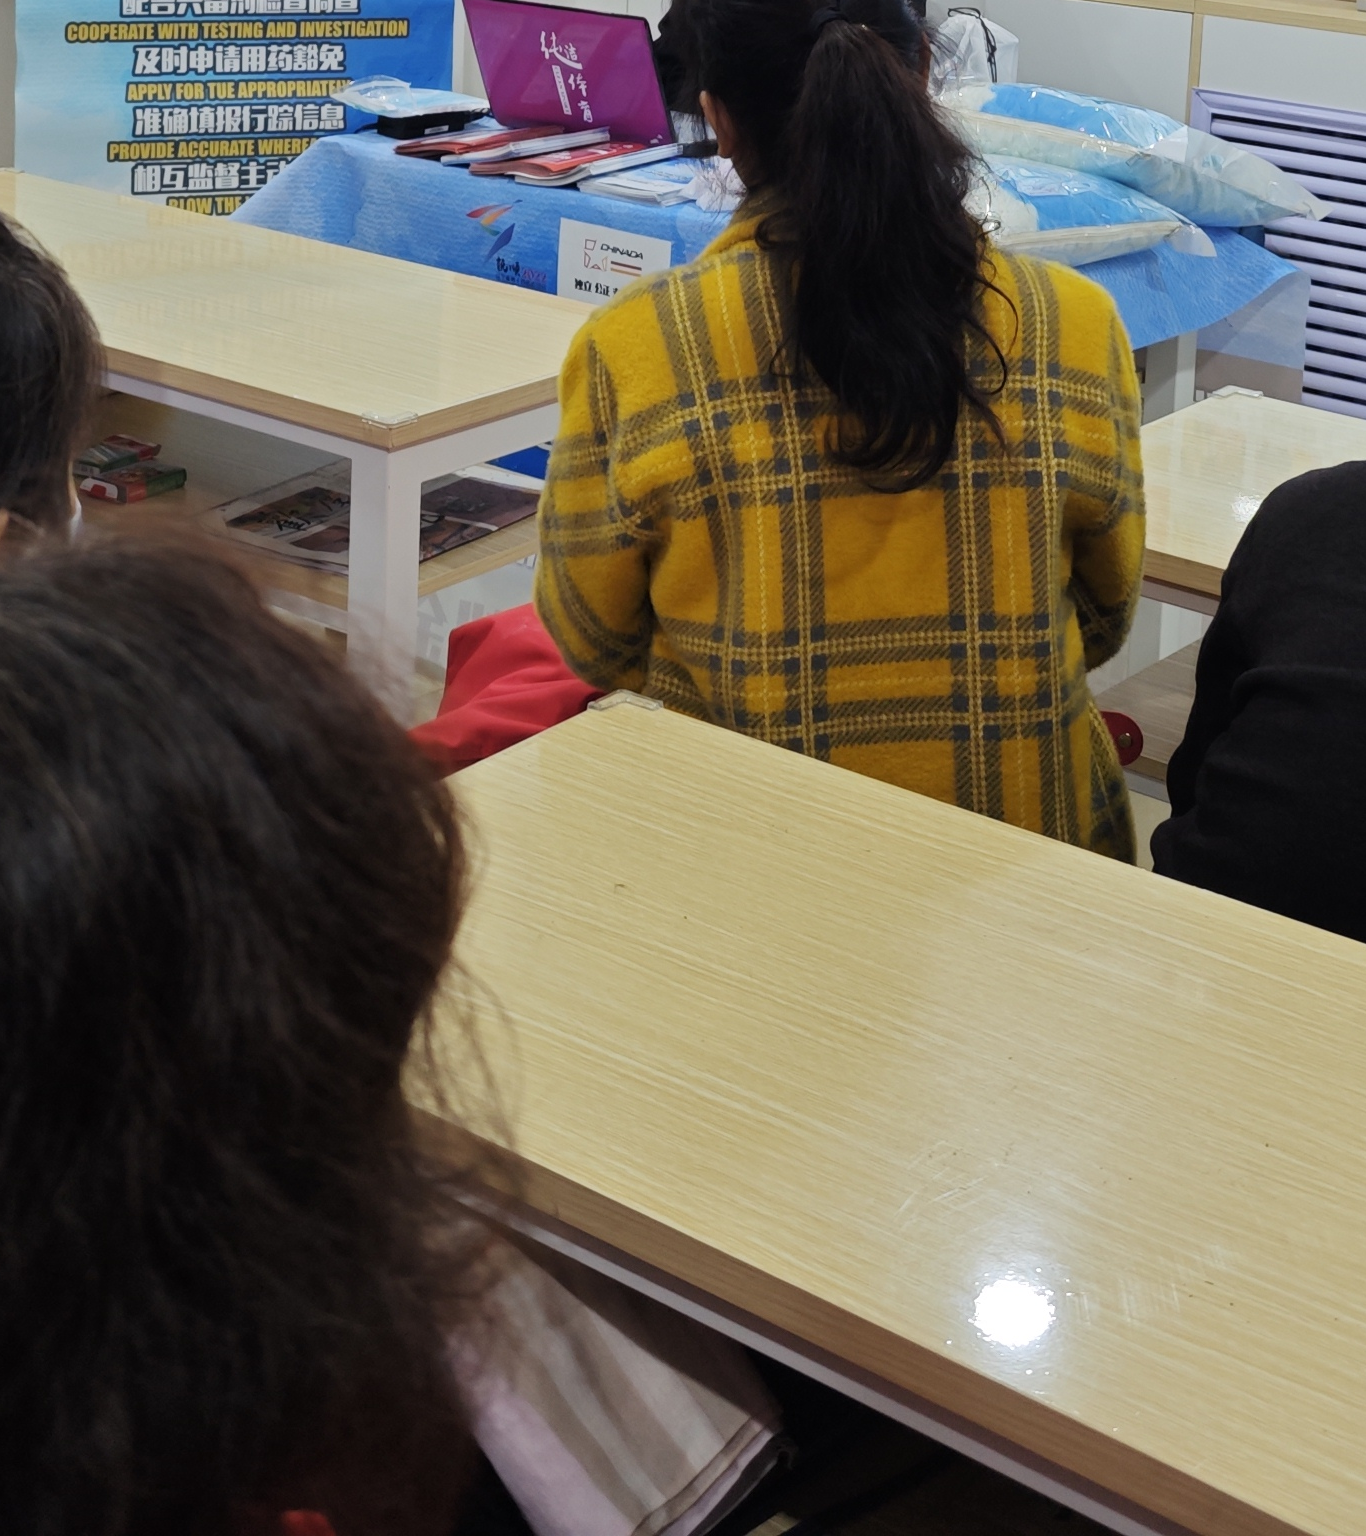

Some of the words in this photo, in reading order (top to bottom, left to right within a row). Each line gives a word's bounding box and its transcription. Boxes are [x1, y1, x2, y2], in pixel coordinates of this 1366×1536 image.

[67, 24, 154, 41] COOPERATE
[157, 23, 198, 40] WITH
[202, 22, 263, 39] TESTING
[266, 21, 296, 38] AND
[299, 20, 408, 38] INVESTIGATION
[135, 44, 345, 74] 及时申请用药豁免
[128, 84, 172, 101] APPLY
[176, 83, 204, 100] FOR
[207, 82, 235, 99] TUE
[135, 104, 344, 135] 准确填报行踪信息
[109, 143, 173, 161] PROVIDE
[177, 141, 255, 159] ACCURATE
